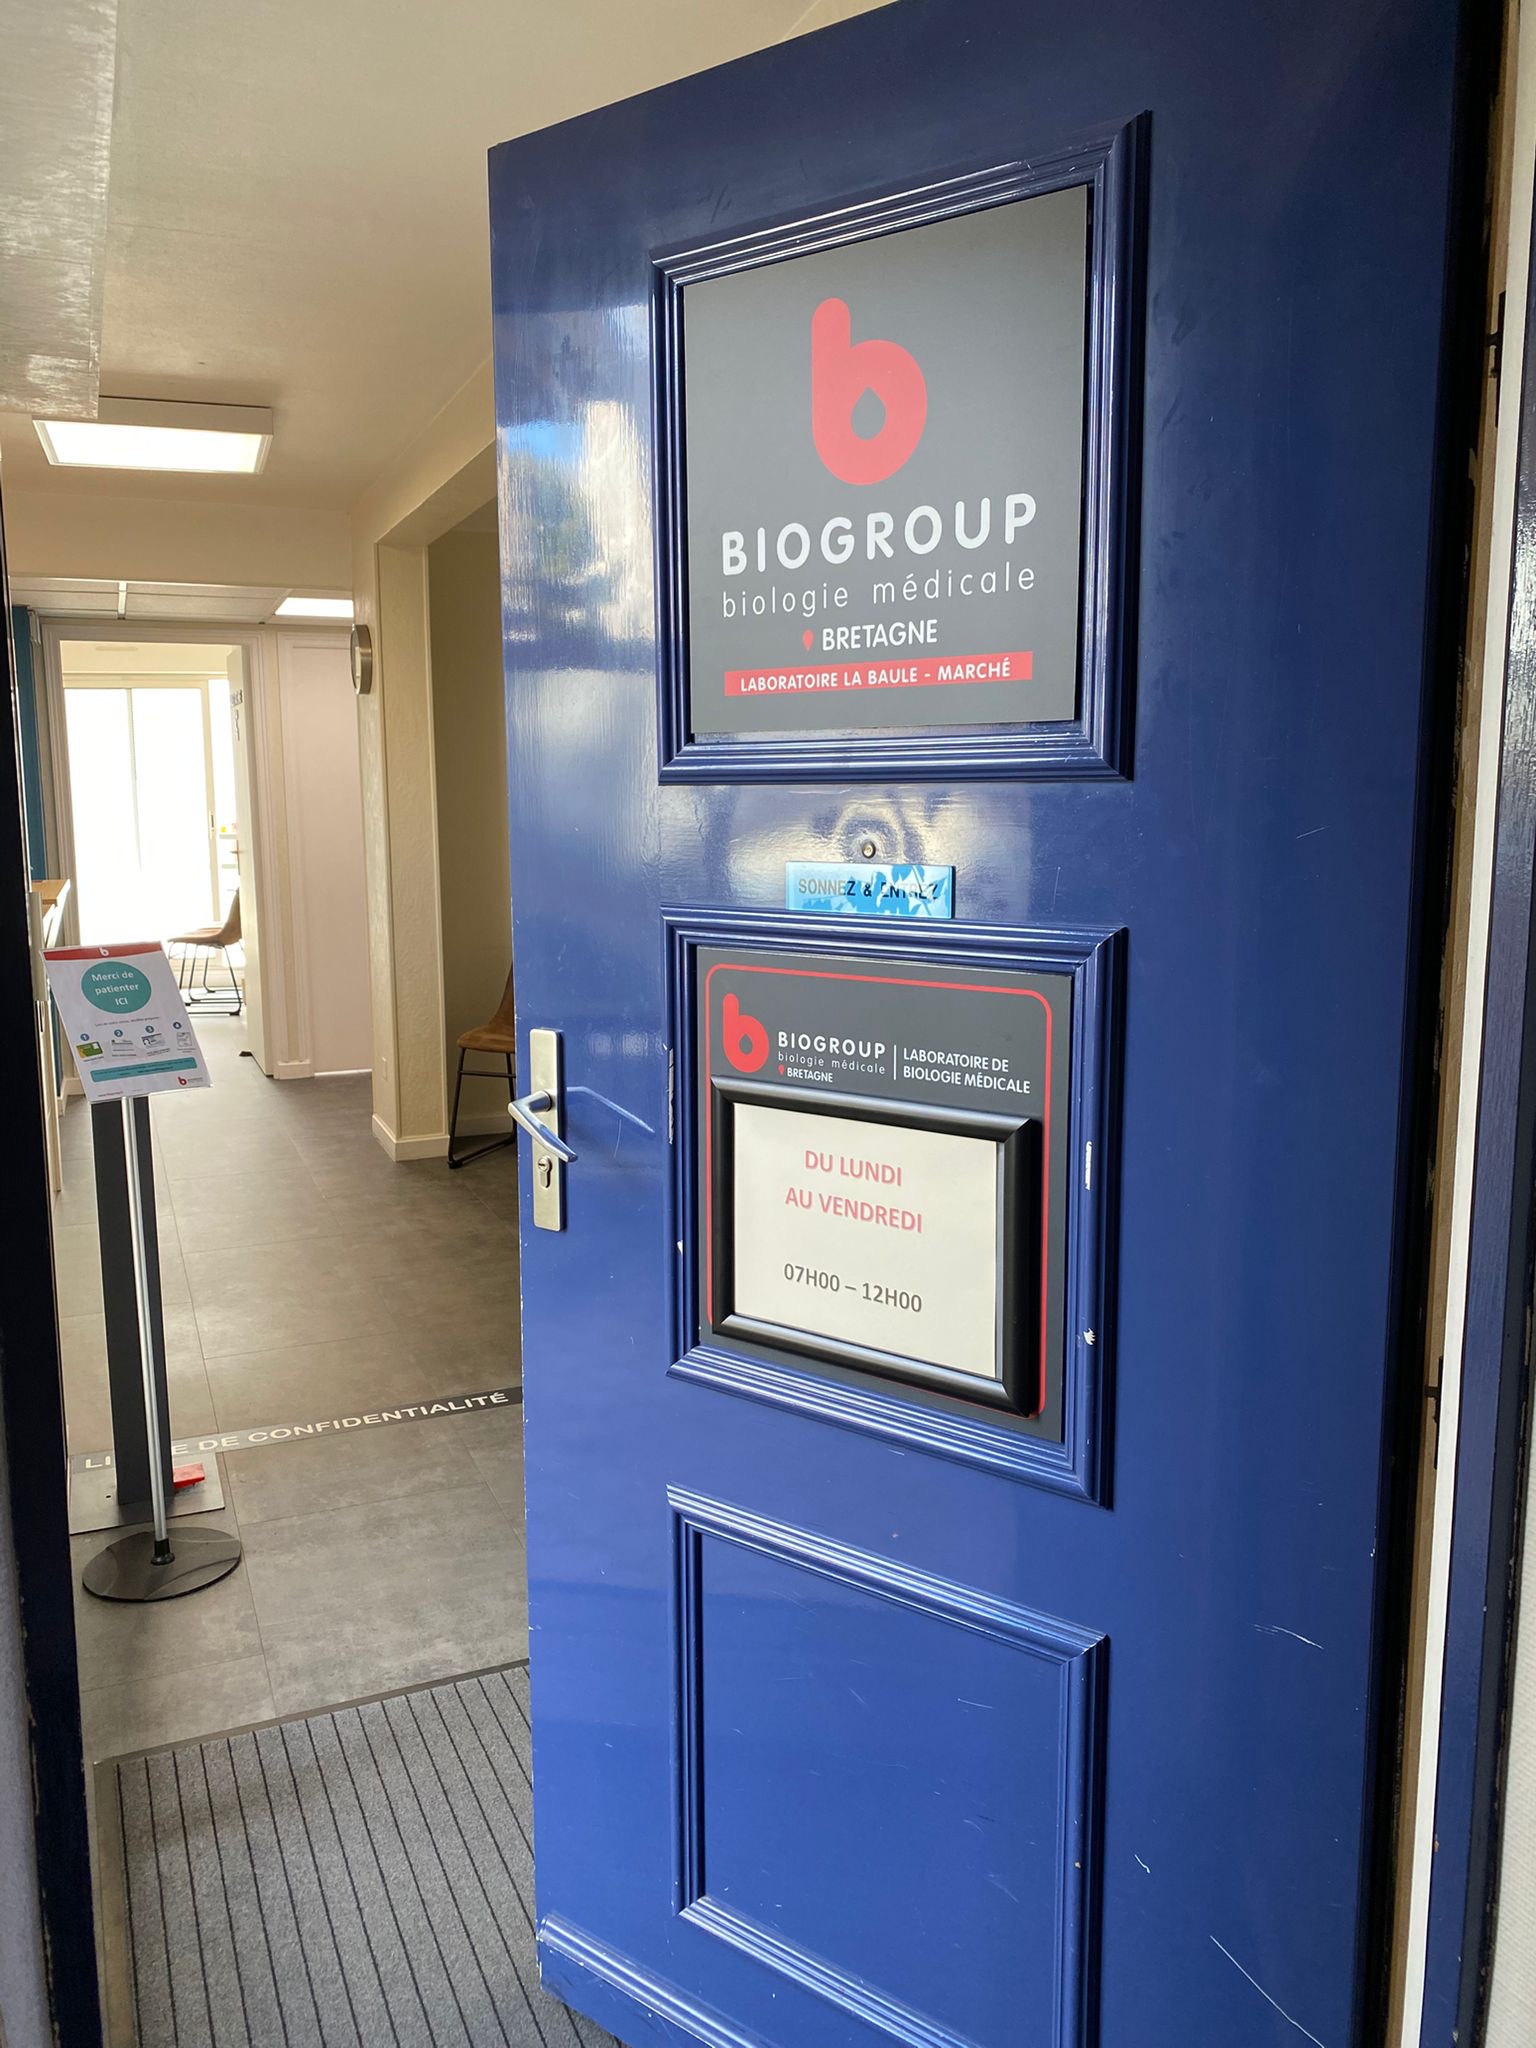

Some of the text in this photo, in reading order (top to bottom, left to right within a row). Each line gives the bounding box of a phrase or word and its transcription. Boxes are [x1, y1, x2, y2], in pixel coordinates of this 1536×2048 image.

[722, 493, 1036, 576] BIOGROUP
[723, 561, 1035, 618] biologie médicale
[822, 619, 938, 651] BRETAGNE
[740, 671, 838, 692] LABORATOIRE
[844, 670, 862, 687] LA
[868, 667, 918, 685] BAULE
[937, 657, 1011, 681] MARCHÉ
[798, 878, 856, 897] SONNEZ
[863, 884, 872, 897] &
[92, 970, 134, 982] Merci de
[95, 984, 139, 996] patienter
[115, 997, 128, 1006] ICI
[778, 1031, 886, 1059] BIOGROUP
[778, 1051, 886, 1075] biologie médicale
[903, 1048, 1009, 1073] LABORATOIRE DE
[787, 1067, 833, 1083] BRETAGNE
[903, 1066, 1031, 1094] BIOLOGIE MÉDICALE
[805, 1150, 902, 1186] DU LUNDI
[785, 1187, 922, 1233] AU VENDREDI
[784, 1263, 840, 1292] 07H00
[862, 1282, 922, 1312] 12H00
[85, 1392, 509, 1469] LIE DE CONFIDENTIALITÉ
